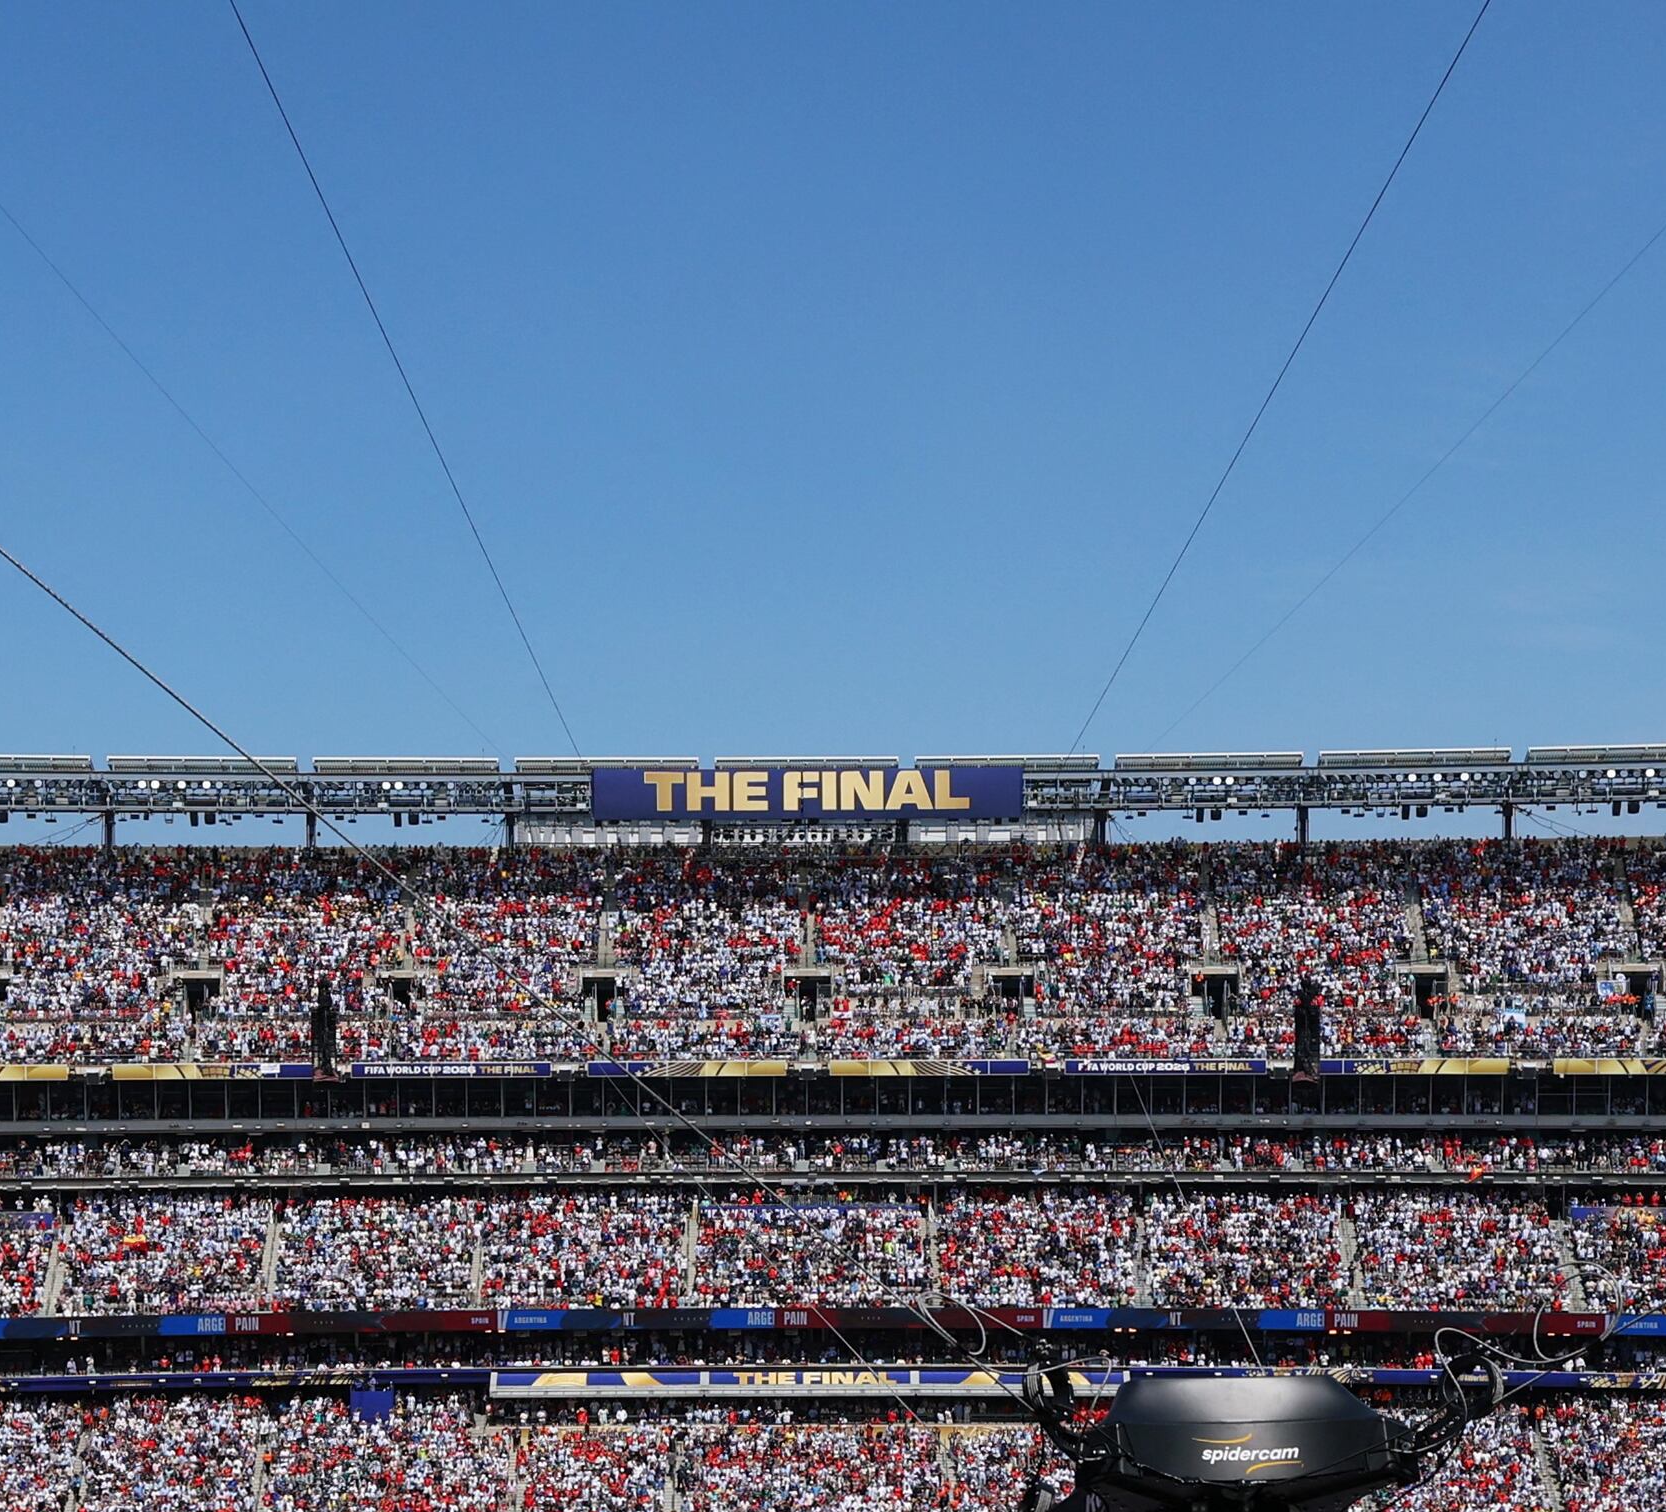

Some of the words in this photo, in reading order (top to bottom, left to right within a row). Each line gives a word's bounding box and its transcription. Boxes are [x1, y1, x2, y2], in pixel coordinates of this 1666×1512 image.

[644, 771, 769, 812] THE
[783, 770, 970, 811] FINAL
[364, 1066, 386, 1075] FIFA
[387, 1066, 420, 1075] WORLD
[421, 1066, 441, 1074] CUP
[442, 1066, 476, 1075] 2026
[479, 1066, 503, 1074] THE
[504, 1066, 537, 1074] FINAL
[1104, 1063, 1137, 1071] WORLD
[1138, 1063, 1155, 1071] CUP
[1156, 1063, 1190, 1071] 2026
[1193, 1063, 1217, 1071] THE
[1219, 1063, 1252, 1071] FINAL
[471, 1317, 489, 1325] SPAIN
[514, 1316, 548, 1324] ARGENTINA
[1576, 1320, 1596, 1329] SPAIN
[738, 1371, 795, 1385] THE
[803, 1371, 897, 1385] FINAL
[1201, 1444, 1300, 1464] spidercam
